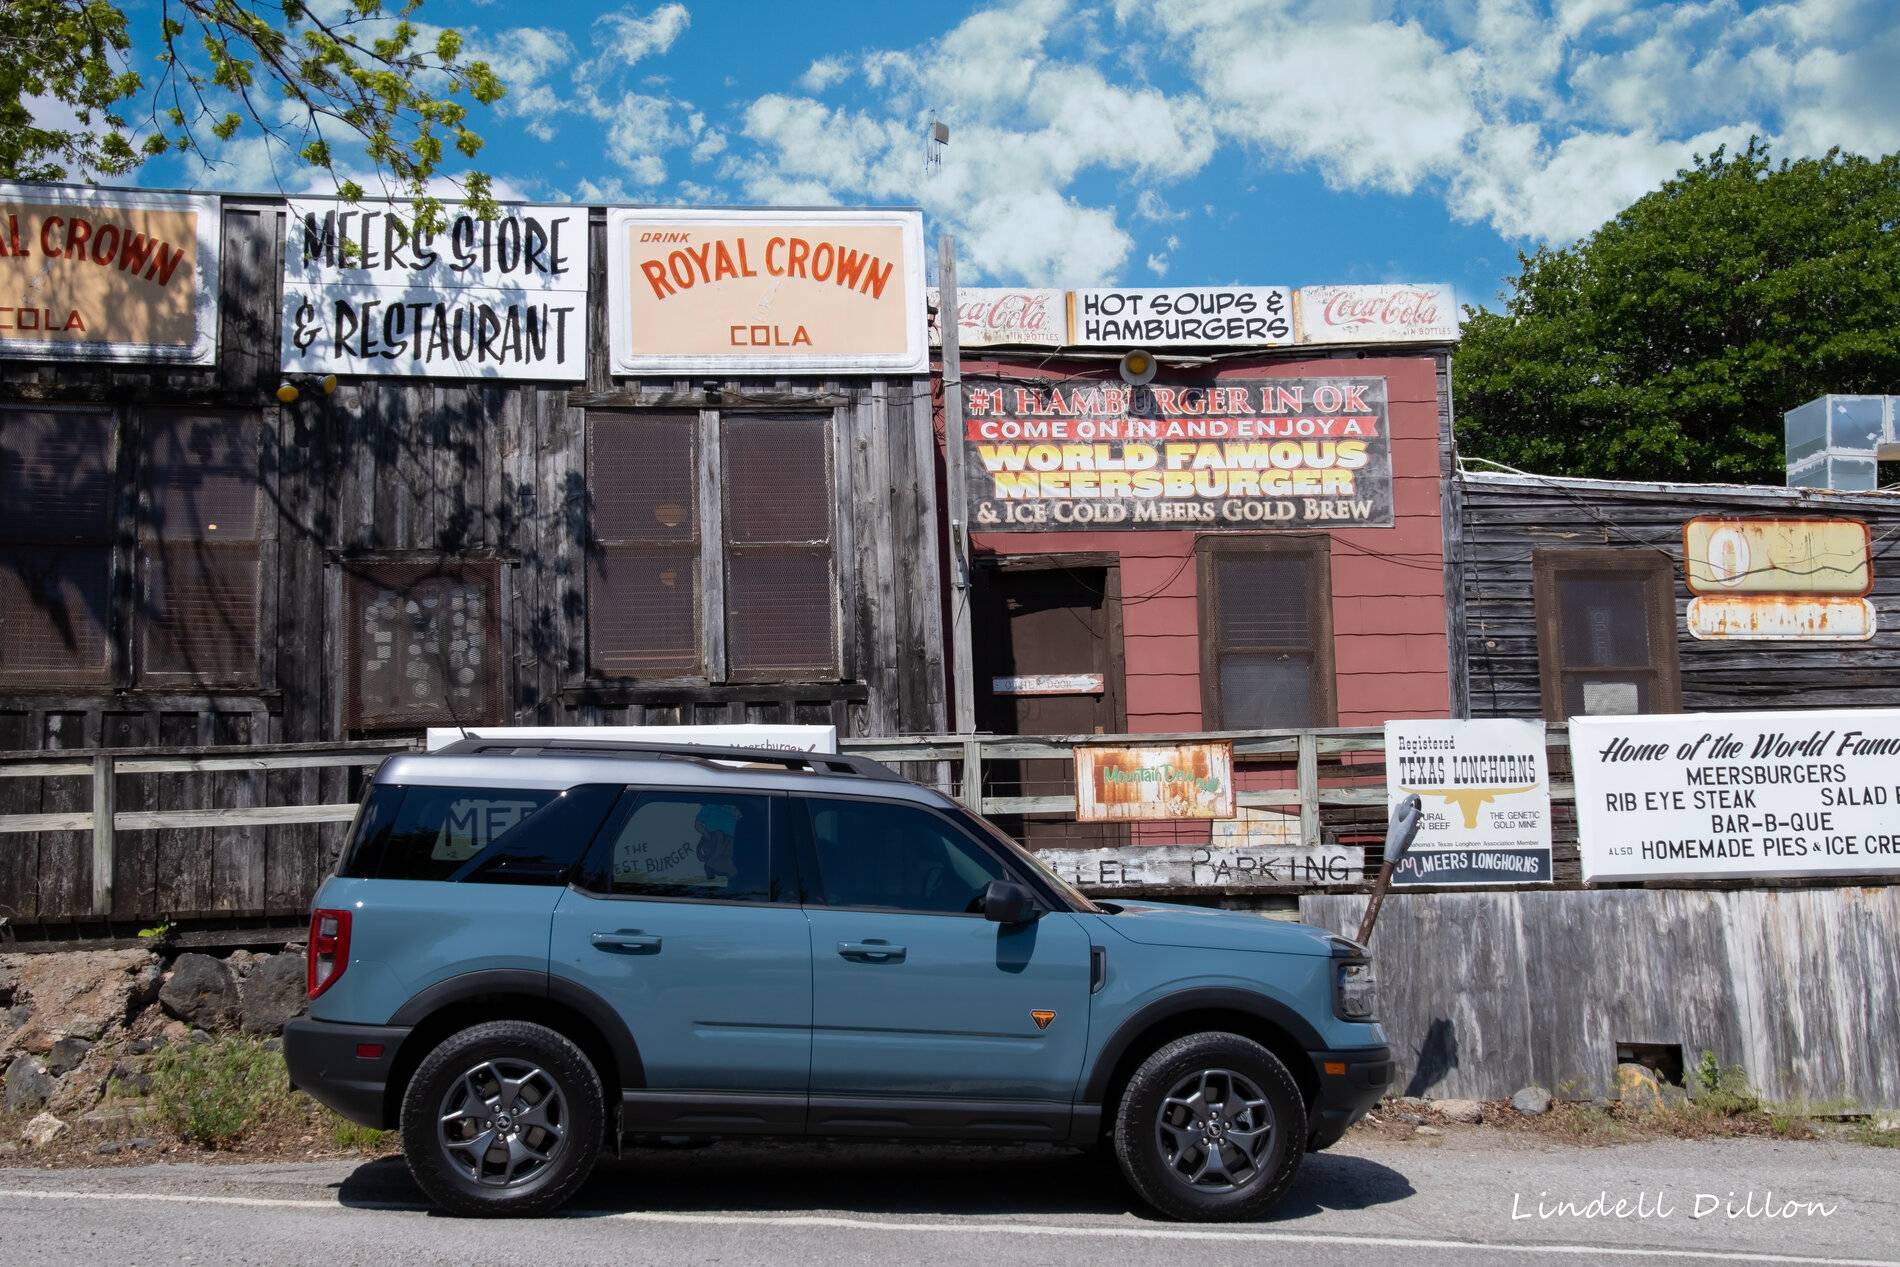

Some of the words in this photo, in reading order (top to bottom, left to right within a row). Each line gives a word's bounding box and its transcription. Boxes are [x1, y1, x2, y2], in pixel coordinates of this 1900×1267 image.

[304, 210, 438, 270] MEERS
[452, 214, 570, 275] STORE
[640, 232, 691, 243] DRINK
[41, 216, 184, 286] CROWN
[640, 237, 757, 300] ROYAL
[765, 236, 893, 299] CROWN
[1085, 294, 1143, 315] HOT
[1150, 293, 1257, 315] SOUPS
[1267, 290, 1284, 315] &
[294, 301, 323, 357] &
[334, 300, 575, 365] RESTAURANT
[731, 325, 812, 346] COLA
[1086, 318, 1289, 341] HAMBURGERS
[969, 388, 1006, 416] #1
[1015, 386, 1255, 416] HAMBURGER
[1261, 386, 1304, 413] IN
[1313, 385, 1372, 413] OK
[980, 421, 1069, 438] COME
[1076, 421, 1117, 438] ON
[1124, 421, 1157, 438] IN
[1166, 420, 1228, 437] AND
[1237, 418, 1336, 436] ENJOY
[1344, 418, 1363, 435] A
[977, 443, 1159, 471] WORLD
[1165, 440, 1369, 470] FAMOUS
[994, 468, 1355, 499] MEERSBURGER
[977, 501, 1001, 524] &
[1399, 736, 1455, 754] Registered
[1599, 737, 1670, 762] Home
[1676, 733, 1712, 761] of
[1708, 733, 1743, 759] the
[1750, 730, 1835, 759] World
[1103, 766, 1162, 785] Mountain
[1163, 764, 1195, 784] Dew
[1399, 756, 1445, 784] TEXAS
[1453, 755, 1536, 784] LONGHORNS
[1686, 764, 1846, 786] MEERSBURGERS
[1606, 792, 1637, 811] RIB
[1645, 791, 1686, 811] EYE
[1693, 789, 1756, 810] STEAK
[1821, 786, 1887, 806] SALAD
[1423, 813, 1446, 821] URAL
[1428, 822, 1450, 830] BEEF
[1490, 812, 1504, 820] THE
[1507, 811, 1541, 819] GENETIC
[1493, 821, 1515, 829] GOLD
[1518, 820, 1537, 829] MINE
[1712, 812, 1834, 834] BAR-B-QUE
[614, 859, 639, 875] EST
[646, 842, 696, 873] BURGER
[624, 842, 648, 855] THE
[1608, 847, 1633, 855] ALSO
[1641, 838, 1755, 859] HOMEMADE
[1763, 837, 1808, 857] PIES
[1812, 842, 1822, 852] &
[1825, 835, 1859, 855] ICE
[1422, 852, 1468, 873] MEERS
[1472, 852, 1539, 873] LONGHORNS
